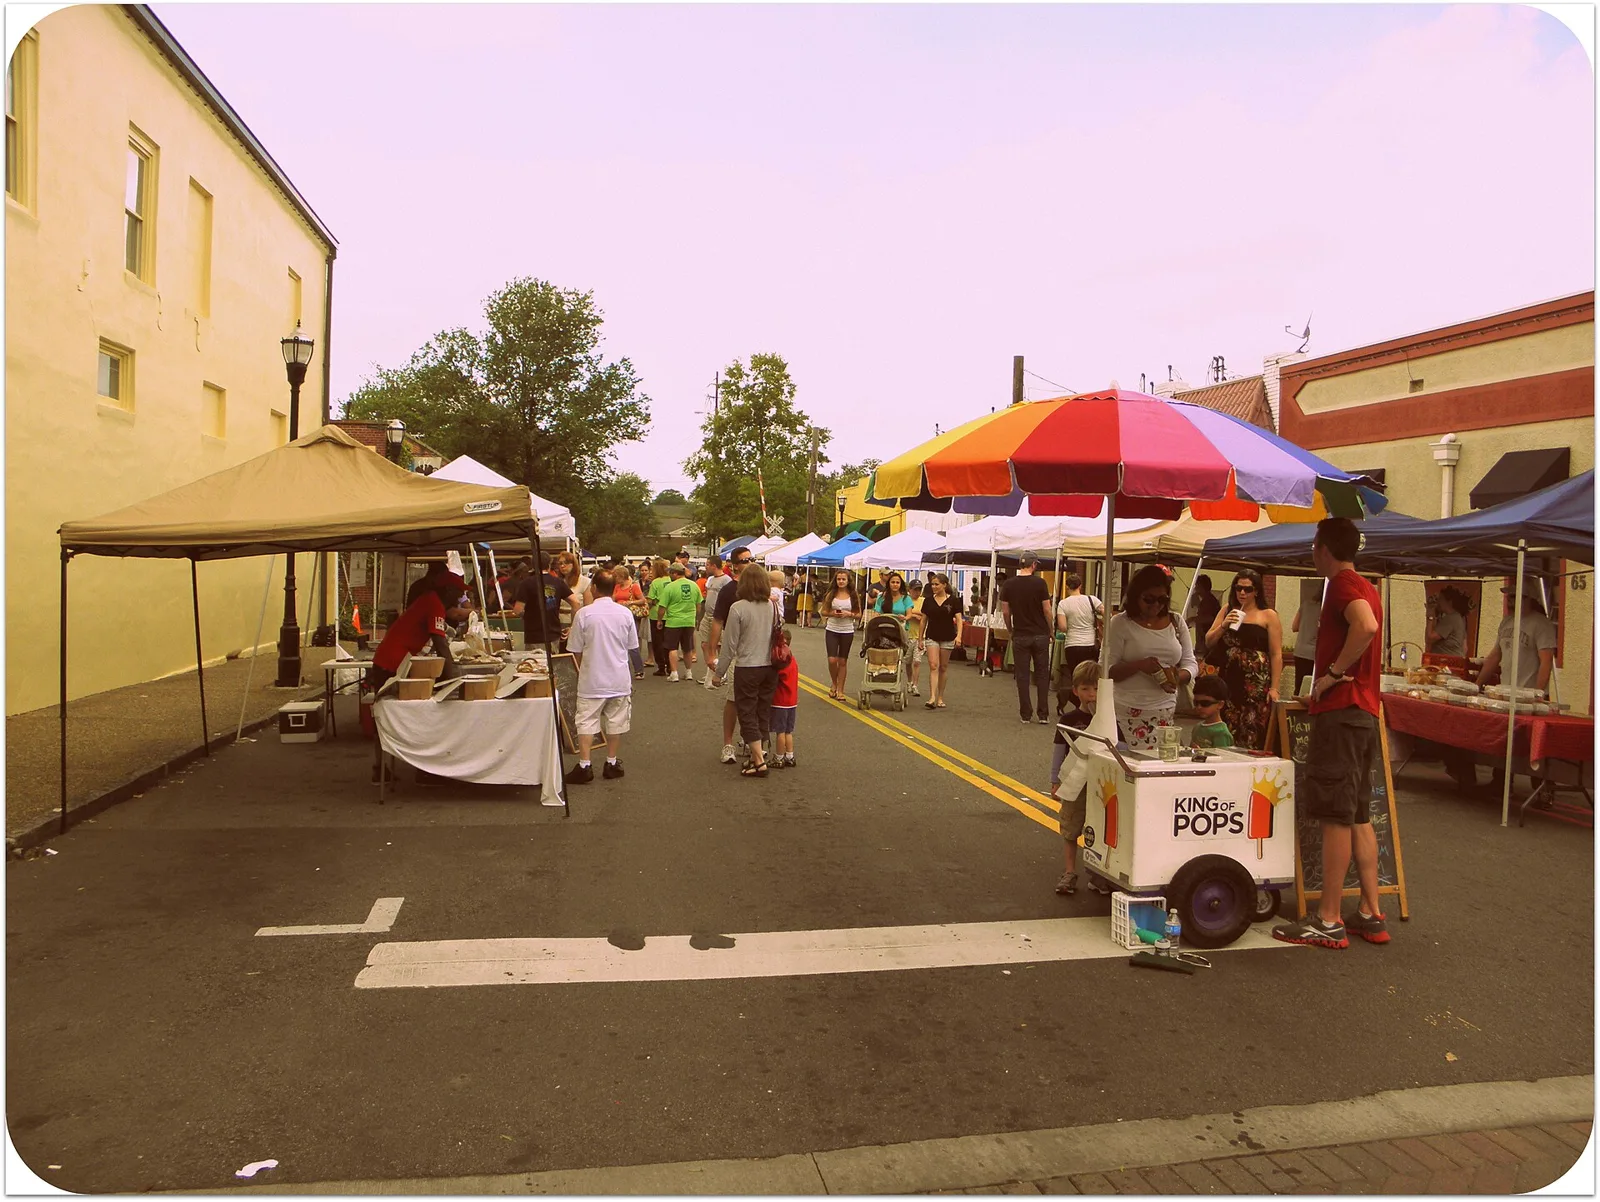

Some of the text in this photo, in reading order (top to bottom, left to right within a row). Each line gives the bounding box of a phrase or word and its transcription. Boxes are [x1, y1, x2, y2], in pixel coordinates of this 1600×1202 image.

[1571, 574, 1587, 590] 65
[1173, 796, 1236, 814] KING OF
[1173, 811, 1244, 839] POPS
